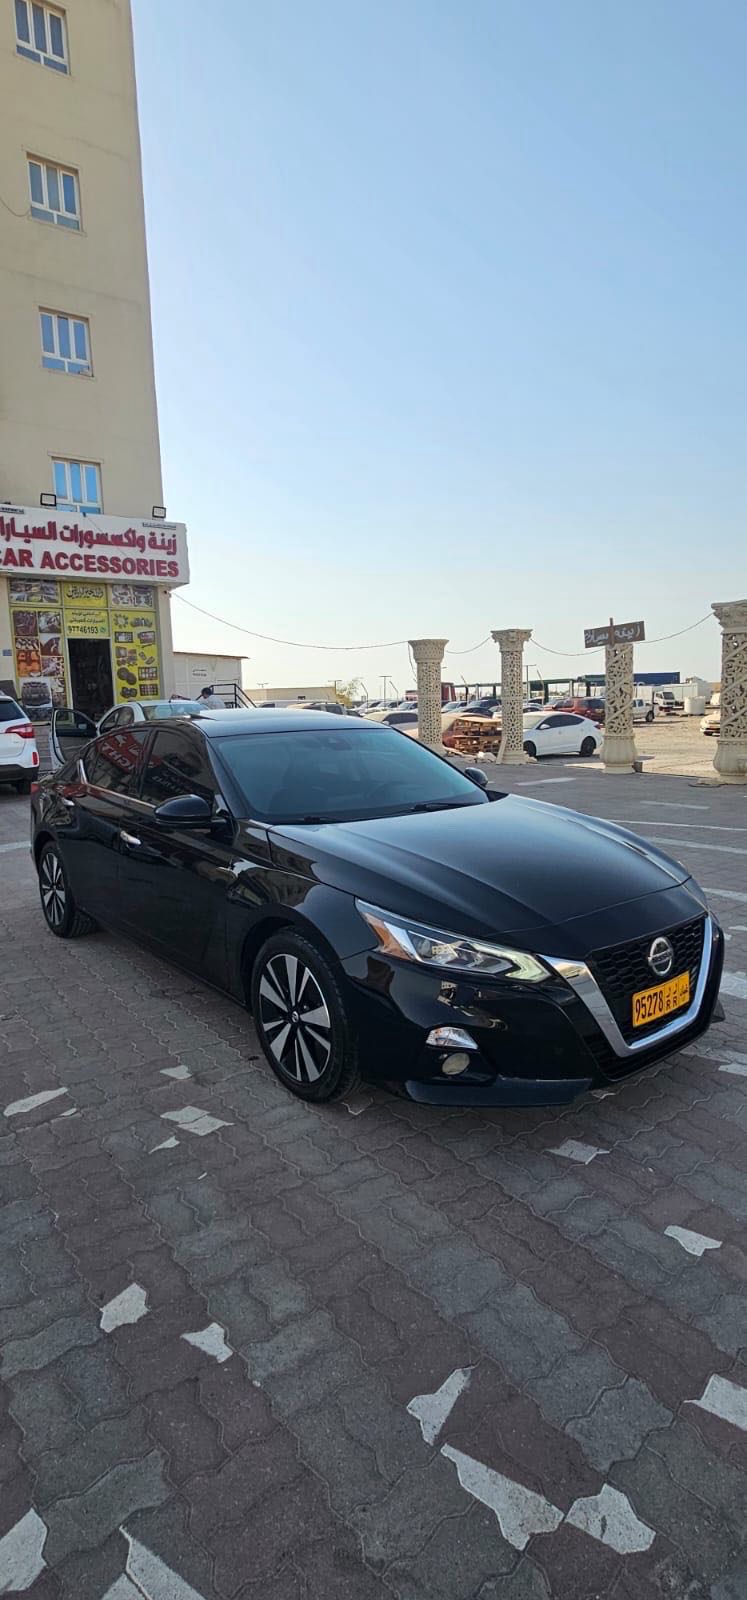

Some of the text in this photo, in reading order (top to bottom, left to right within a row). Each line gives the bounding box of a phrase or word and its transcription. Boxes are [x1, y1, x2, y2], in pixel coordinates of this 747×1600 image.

[0, 516, 57, 543] السيارا
[147, 531, 177, 556] زينة
[40, 550, 179, 578] ACCESSORIES
[68, 625, 99, 634] 97746193
[635, 989, 664, 1022] 95278
